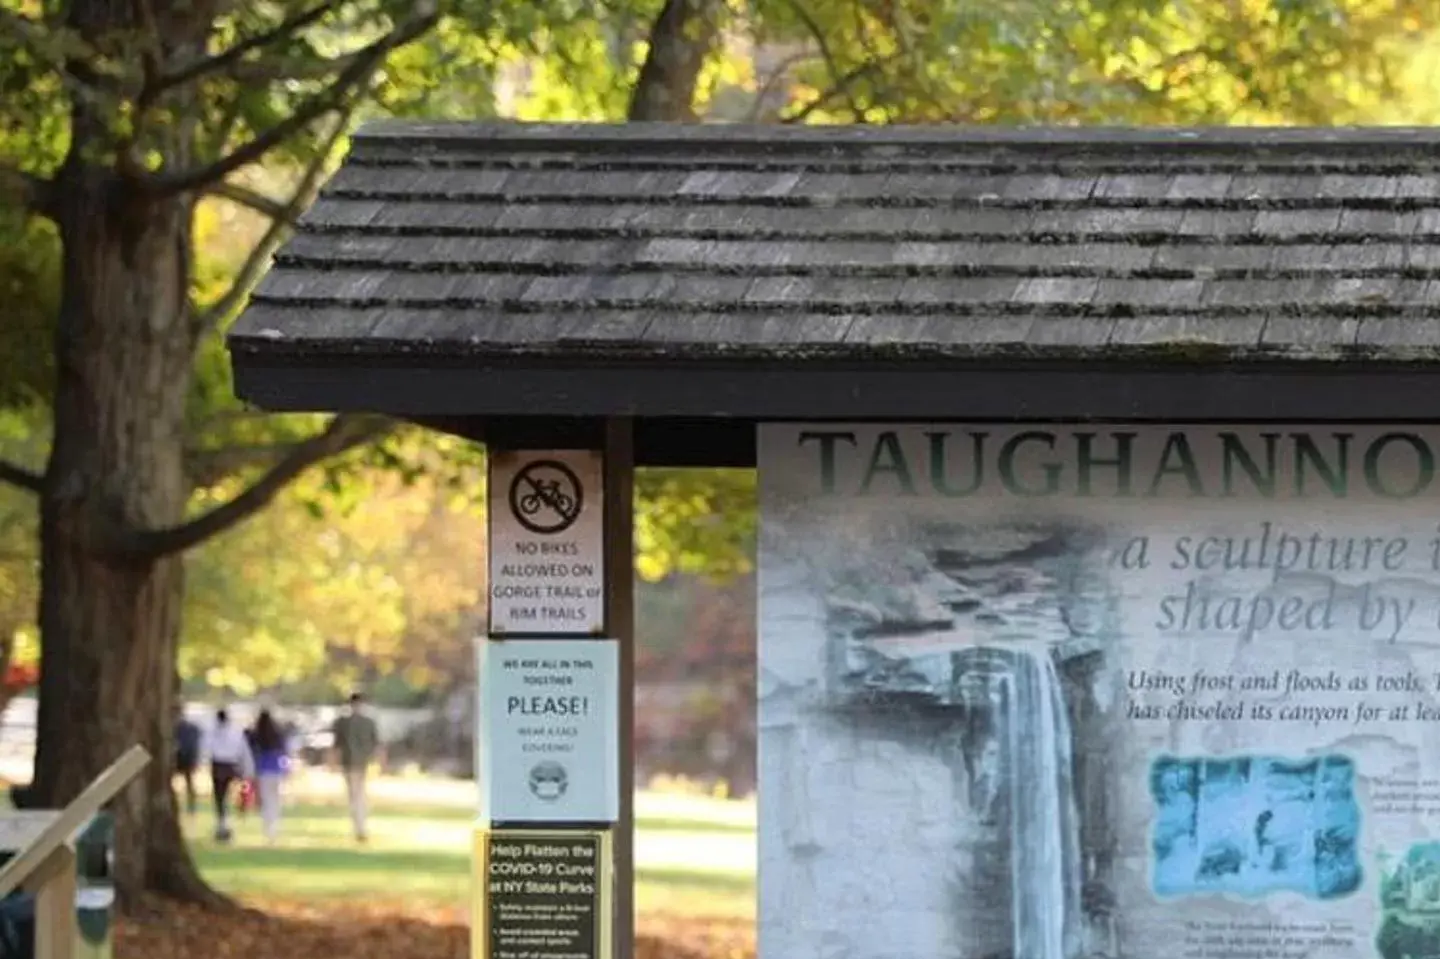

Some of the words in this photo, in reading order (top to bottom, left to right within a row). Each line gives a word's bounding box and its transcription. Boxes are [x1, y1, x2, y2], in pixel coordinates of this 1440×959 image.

[515, 541, 538, 556] NO
[1121, 535, 1151, 571] a
[1170, 521, 1408, 583] sculpture
[501, 563, 569, 578] ALLOWED
[571, 563, 594, 578] ON
[493, 584, 541, 599] GORGE
[541, 606, 588, 621] TRAILS
[1155, 580, 1336, 643] shaped
[1358, 580, 1416, 645] by
[1128, 669, 1186, 695] Using
[1191, 669, 1234, 693] frost
[1240, 669, 1280, 692] and
[1284, 669, 1341, 694] floods
[1347, 675, 1369, 692] as
[507, 695, 588, 717] PLEASE!
[1125, 699, 1160, 722] has
[1165, 699, 1244, 722] chiseled
[1249, 701, 1273, 722] its
[1279, 705, 1350, 728] canyon
[1353, 701, 1382, 726] for
[1387, 705, 1409, 722] at
[490, 843, 522, 859] Help
[523, 843, 570, 858] Flatten
[571, 844, 594, 858] the
[489, 862, 554, 877] COVID-19
[556, 862, 595, 877] Curve
[503, 880, 524, 894] NY
[525, 880, 557, 894] State
[559, 880, 595, 895] Parks
